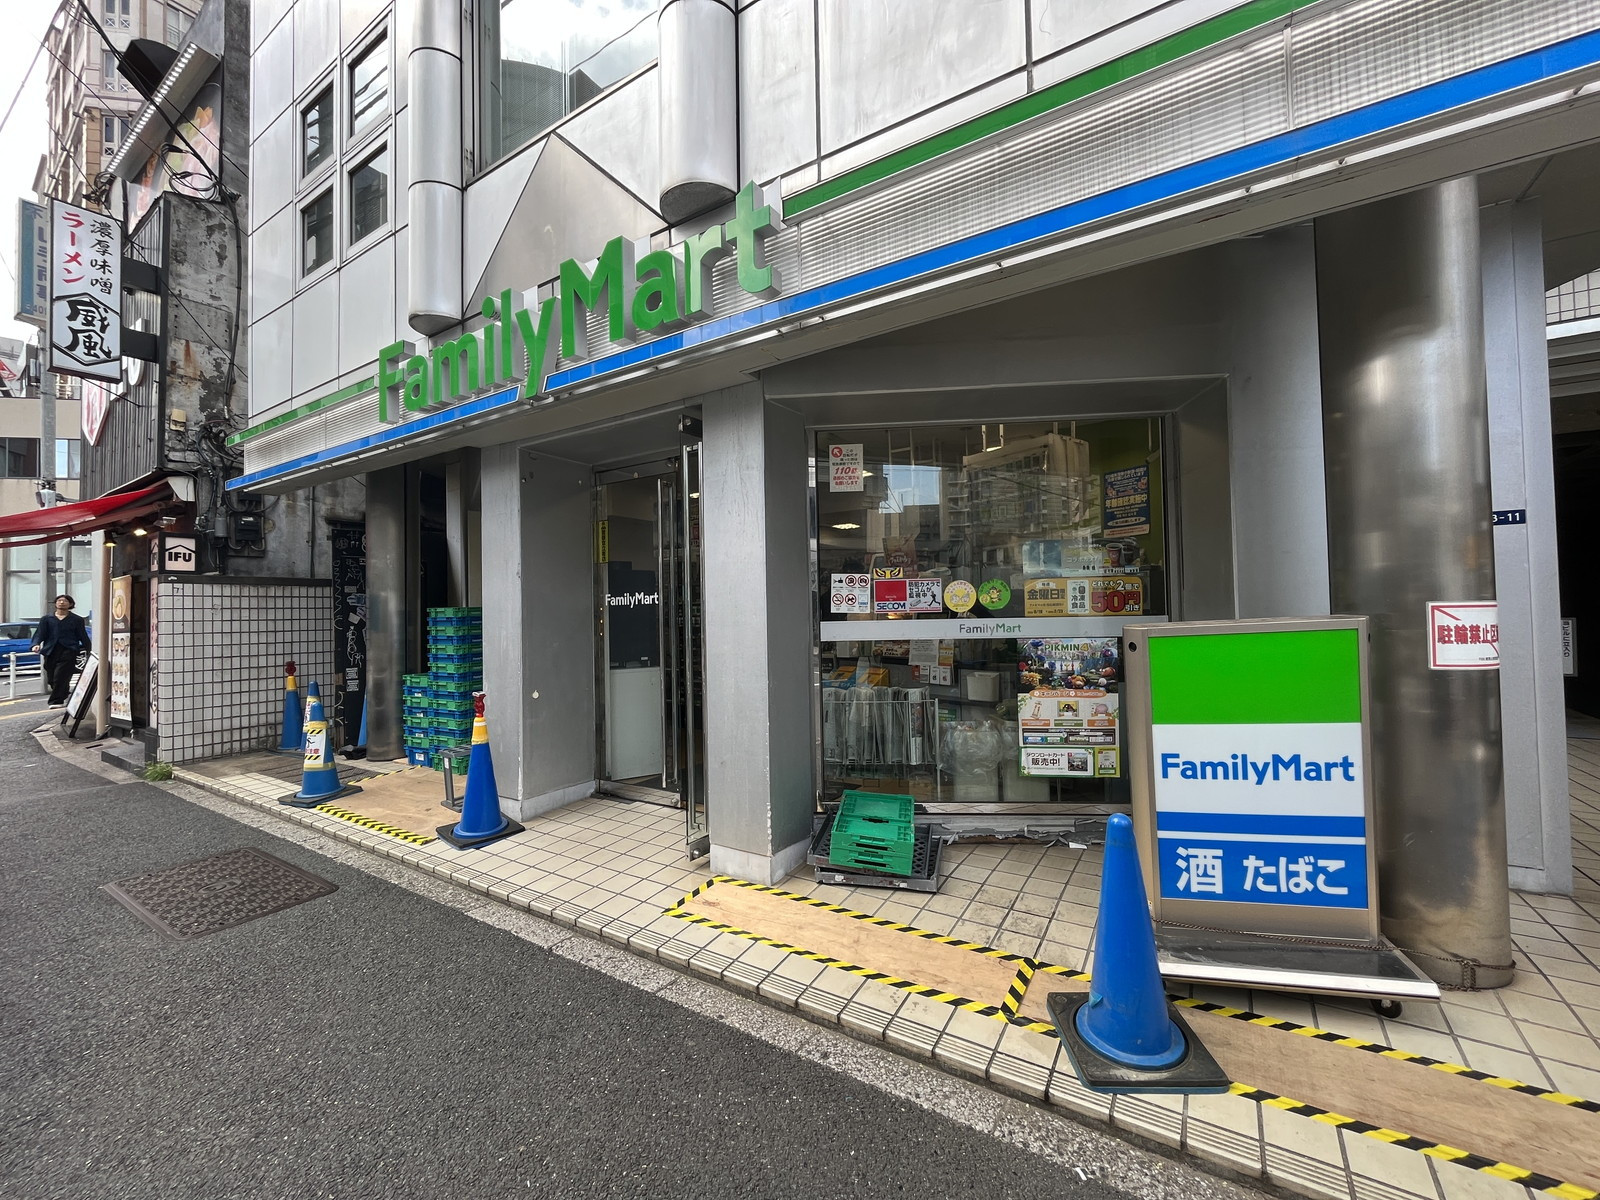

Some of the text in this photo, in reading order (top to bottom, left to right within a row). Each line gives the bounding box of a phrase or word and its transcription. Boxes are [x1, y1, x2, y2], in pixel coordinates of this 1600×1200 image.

[62, 210, 85, 284] ラーメン
[90, 219, 114, 295] 濃厚味噌
[378, 179, 776, 424] FamilyMart
[168, 551, 192, 563] IFU
[605, 592, 659, 608] FamilyMart
[1027, 589, 1060, 600] 金曜日
[876, 602, 906, 611] SECOM
[959, 622, 1022, 636] FamilyMart
[1437, 624, 1498, 645] 駐輪禁止区
[1044, 643, 1090, 652] PIKMIN 4
[1031, 758, 1061, 767] 販売中!
[1160, 752, 1355, 786] FamilyMart
[1175, 846, 1349, 895] 酒 たばこ
